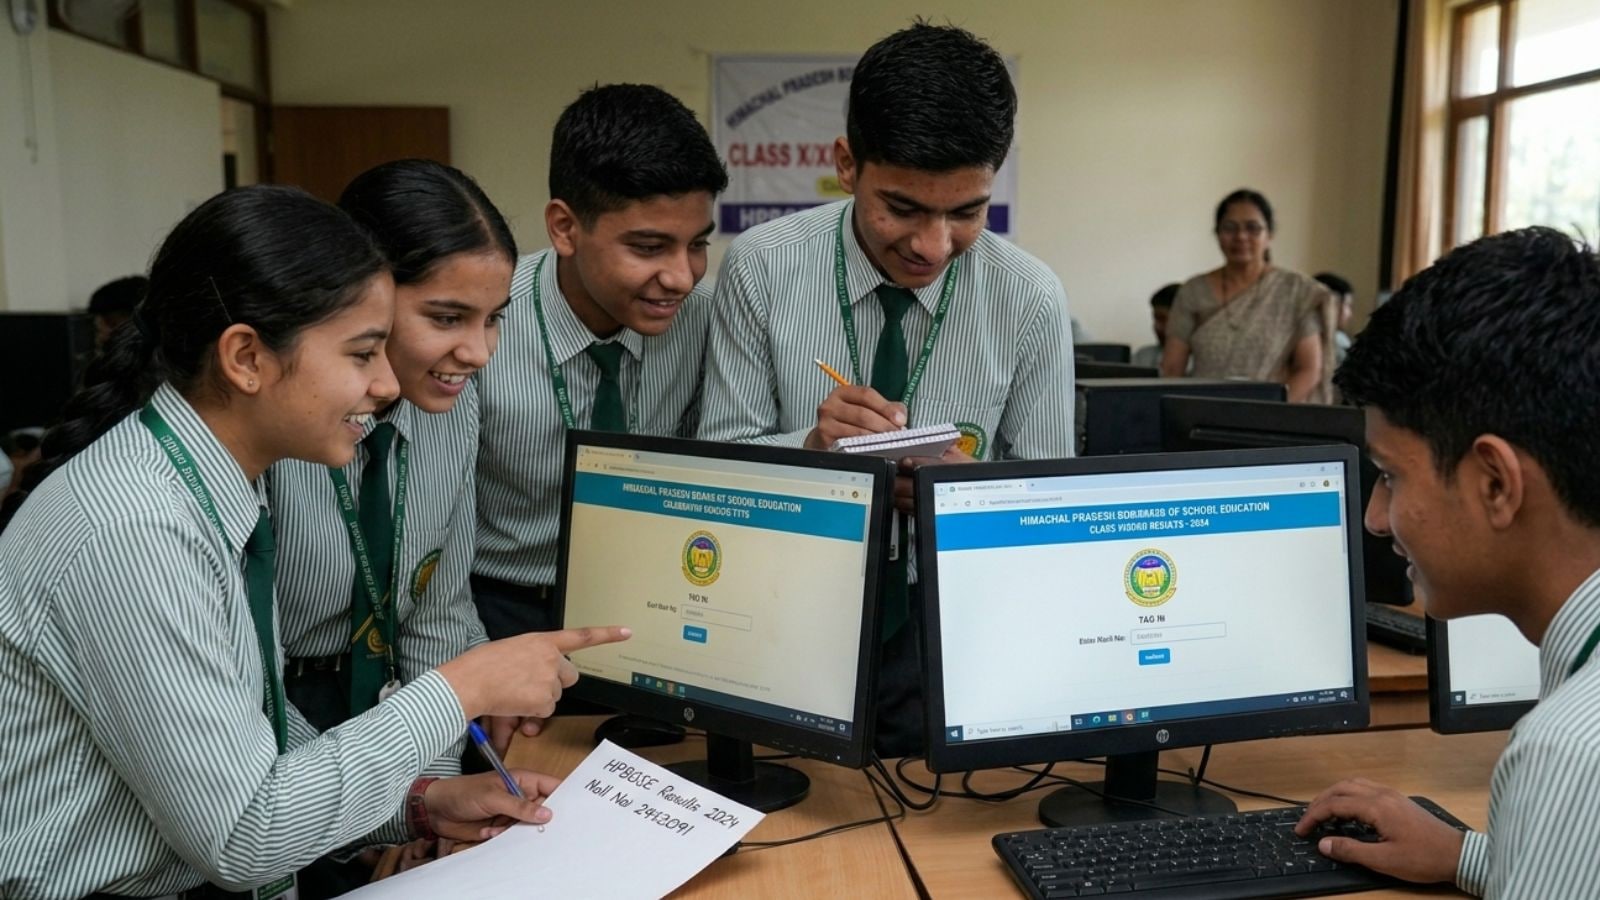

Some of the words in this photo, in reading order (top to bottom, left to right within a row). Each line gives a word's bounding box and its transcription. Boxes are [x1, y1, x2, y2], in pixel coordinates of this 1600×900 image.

[728, 142, 791, 168] CLASS
[1019, 513, 1071, 527] HIMACHAL
[1168, 506, 1180, 517] OF
